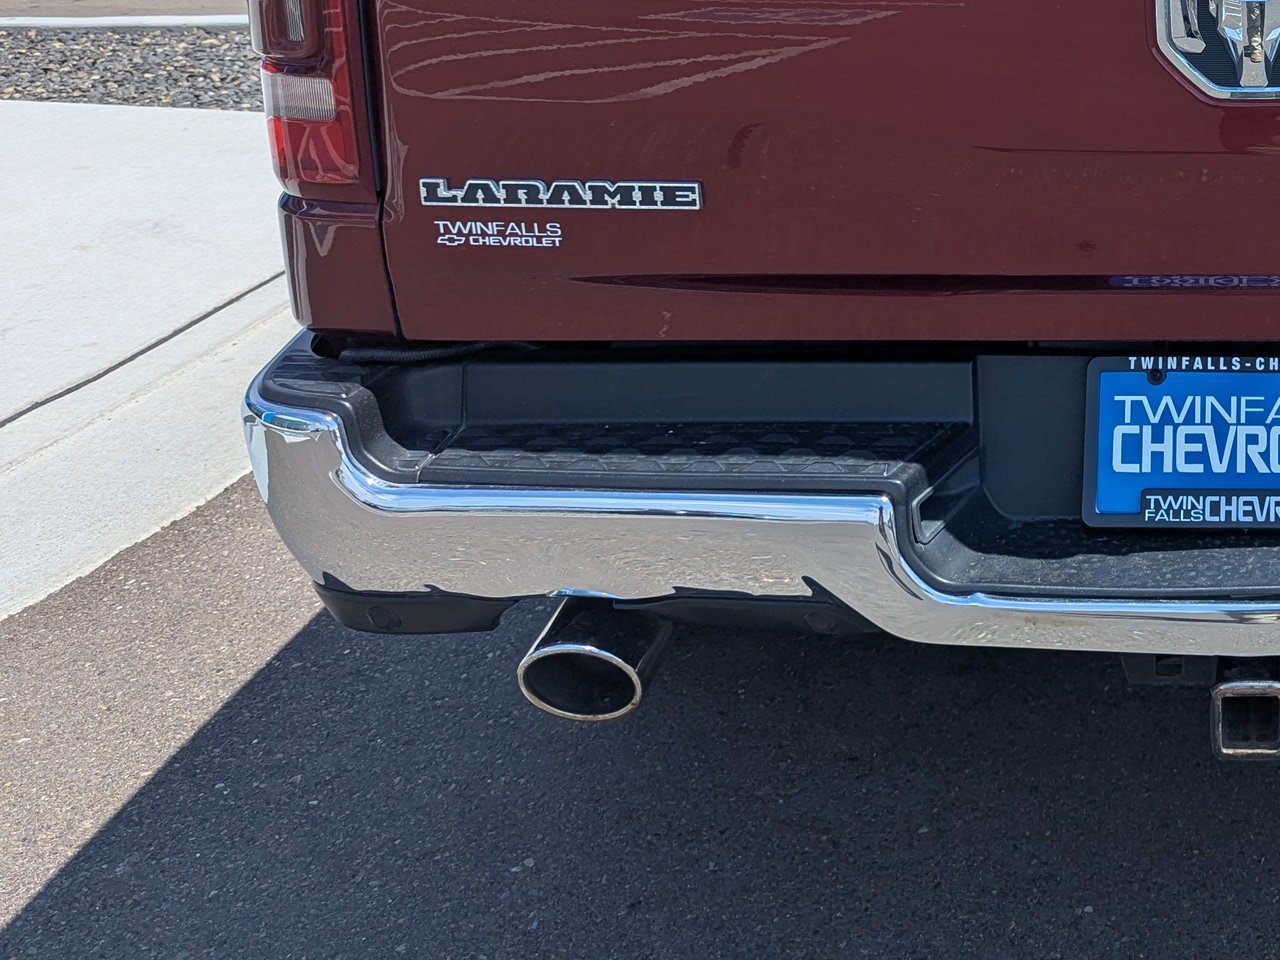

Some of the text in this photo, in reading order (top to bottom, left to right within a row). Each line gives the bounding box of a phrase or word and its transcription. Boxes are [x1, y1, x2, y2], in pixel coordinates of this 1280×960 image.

[419, 178, 702, 210] LARAMIE
[469, 236, 562, 247] CHEVROLET
[1145, 495, 1203, 509] TWIN
[1145, 509, 1203, 521] FALLS
